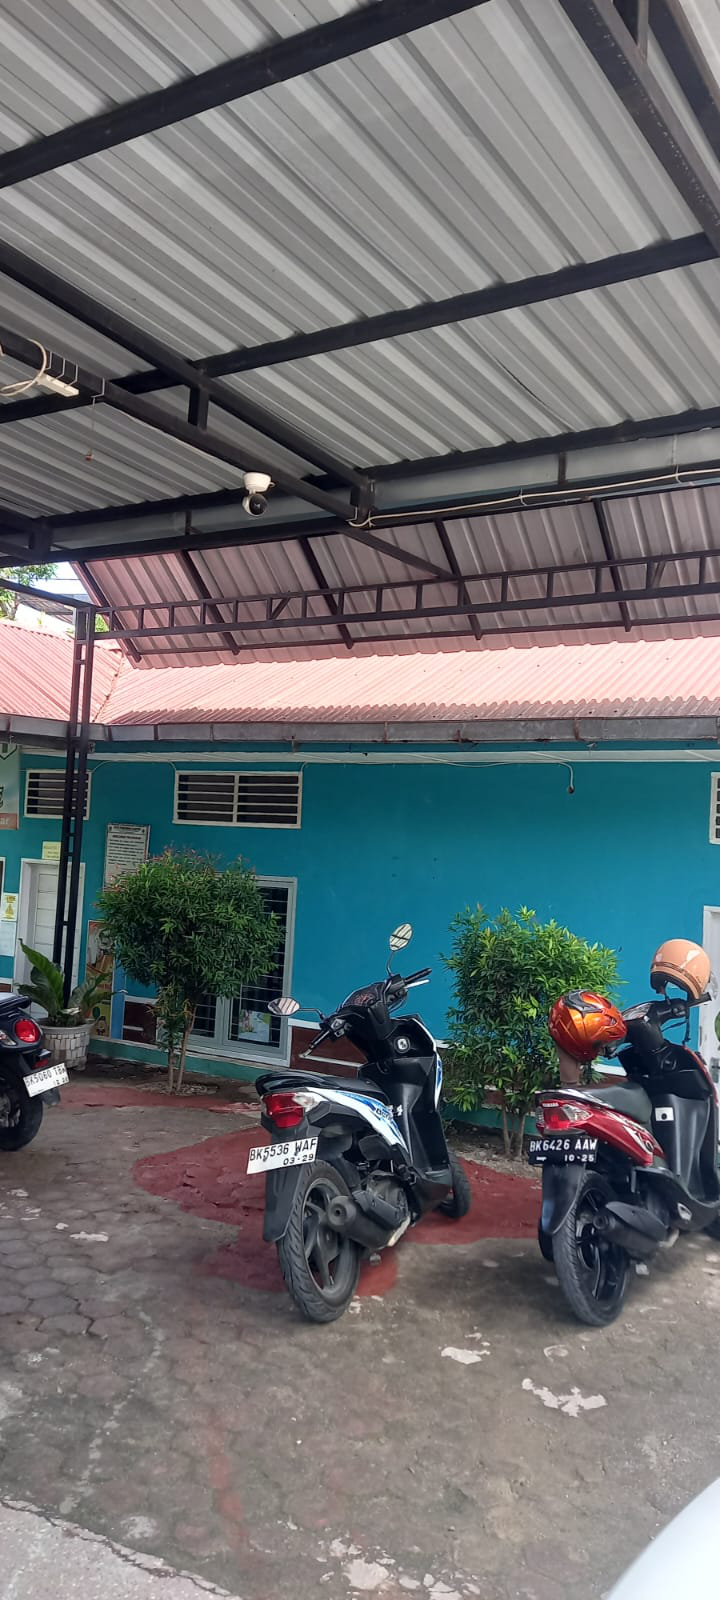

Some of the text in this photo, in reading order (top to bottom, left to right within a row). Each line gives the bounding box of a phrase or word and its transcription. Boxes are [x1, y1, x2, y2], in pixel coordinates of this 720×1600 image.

[294, 1138, 317, 1154] WAF
[575, 1138, 598, 1150] AAW
[283, 1153, 314, 1165] 03-29
[564, 1154, 595, 1162] 10-25
